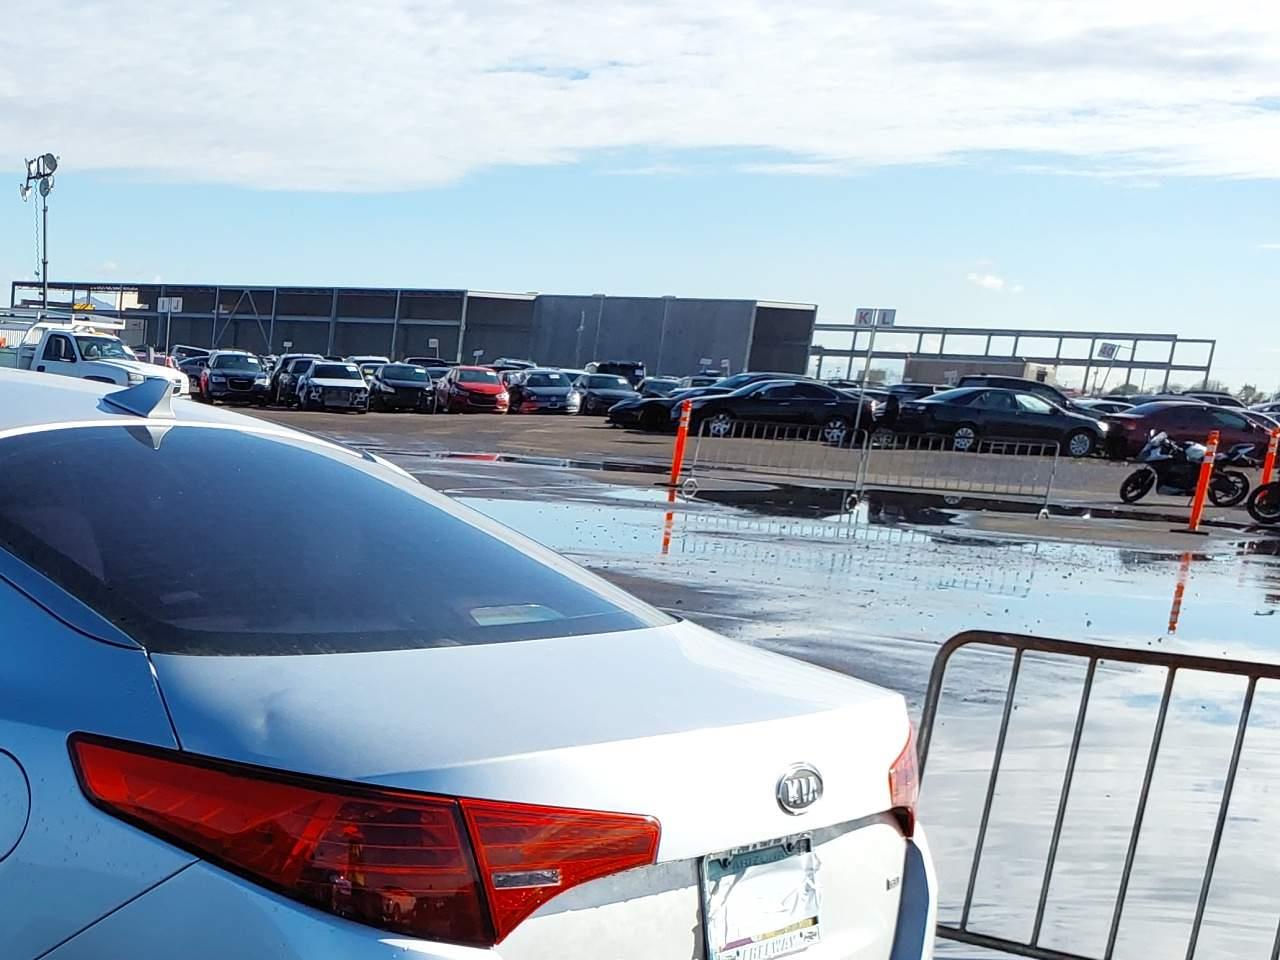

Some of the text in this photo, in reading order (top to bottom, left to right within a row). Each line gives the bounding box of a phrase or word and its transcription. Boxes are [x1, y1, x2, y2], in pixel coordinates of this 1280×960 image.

[858, 311, 869, 324] K
[882, 311, 890, 324] L
[784, 776, 818, 804] KIA
